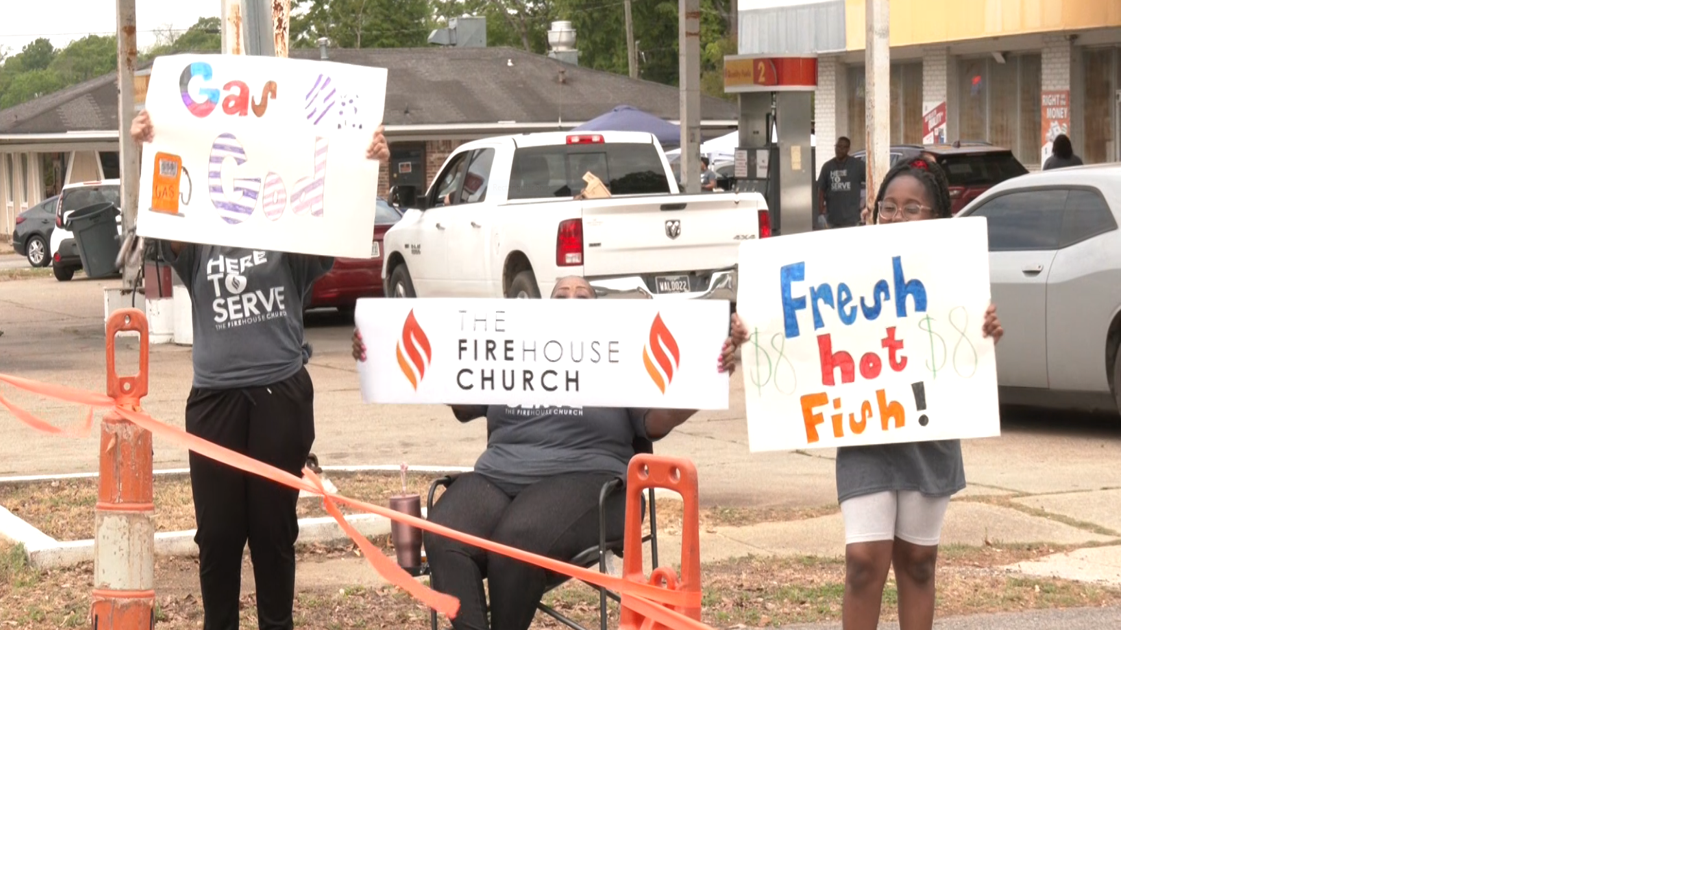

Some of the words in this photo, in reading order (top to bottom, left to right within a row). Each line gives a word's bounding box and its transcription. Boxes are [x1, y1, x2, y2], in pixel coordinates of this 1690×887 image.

[757, 61, 766, 83] 2
[179, 61, 277, 118] Gas
[1042, 94, 1060, 106] RIGHT
[1046, 107, 1068, 119] MONEY
[208, 132, 329, 225] God
[830, 176, 841, 184] TO
[831, 182, 851, 191] SERVE
[155, 185, 175, 199] GAS
[206, 250, 268, 275] HERE
[207, 272, 247, 297] TO
[212, 286, 286, 324] SERVE
[780, 255, 928, 339] Fresh
[215, 323, 227, 331] THE
[227, 314, 266, 329] FIREHOUSE
[458, 310, 506, 333] THE
[458, 339, 620, 364] FIREHOUSE
[918, 305, 978, 380] $8
[749, 327, 797, 397] $8
[816, 326, 908, 387] hot
[456, 368, 580, 392] CHURCH
[516, 408, 552, 416] FIREHOUSE
[553, 408, 584, 416] CHURCH
